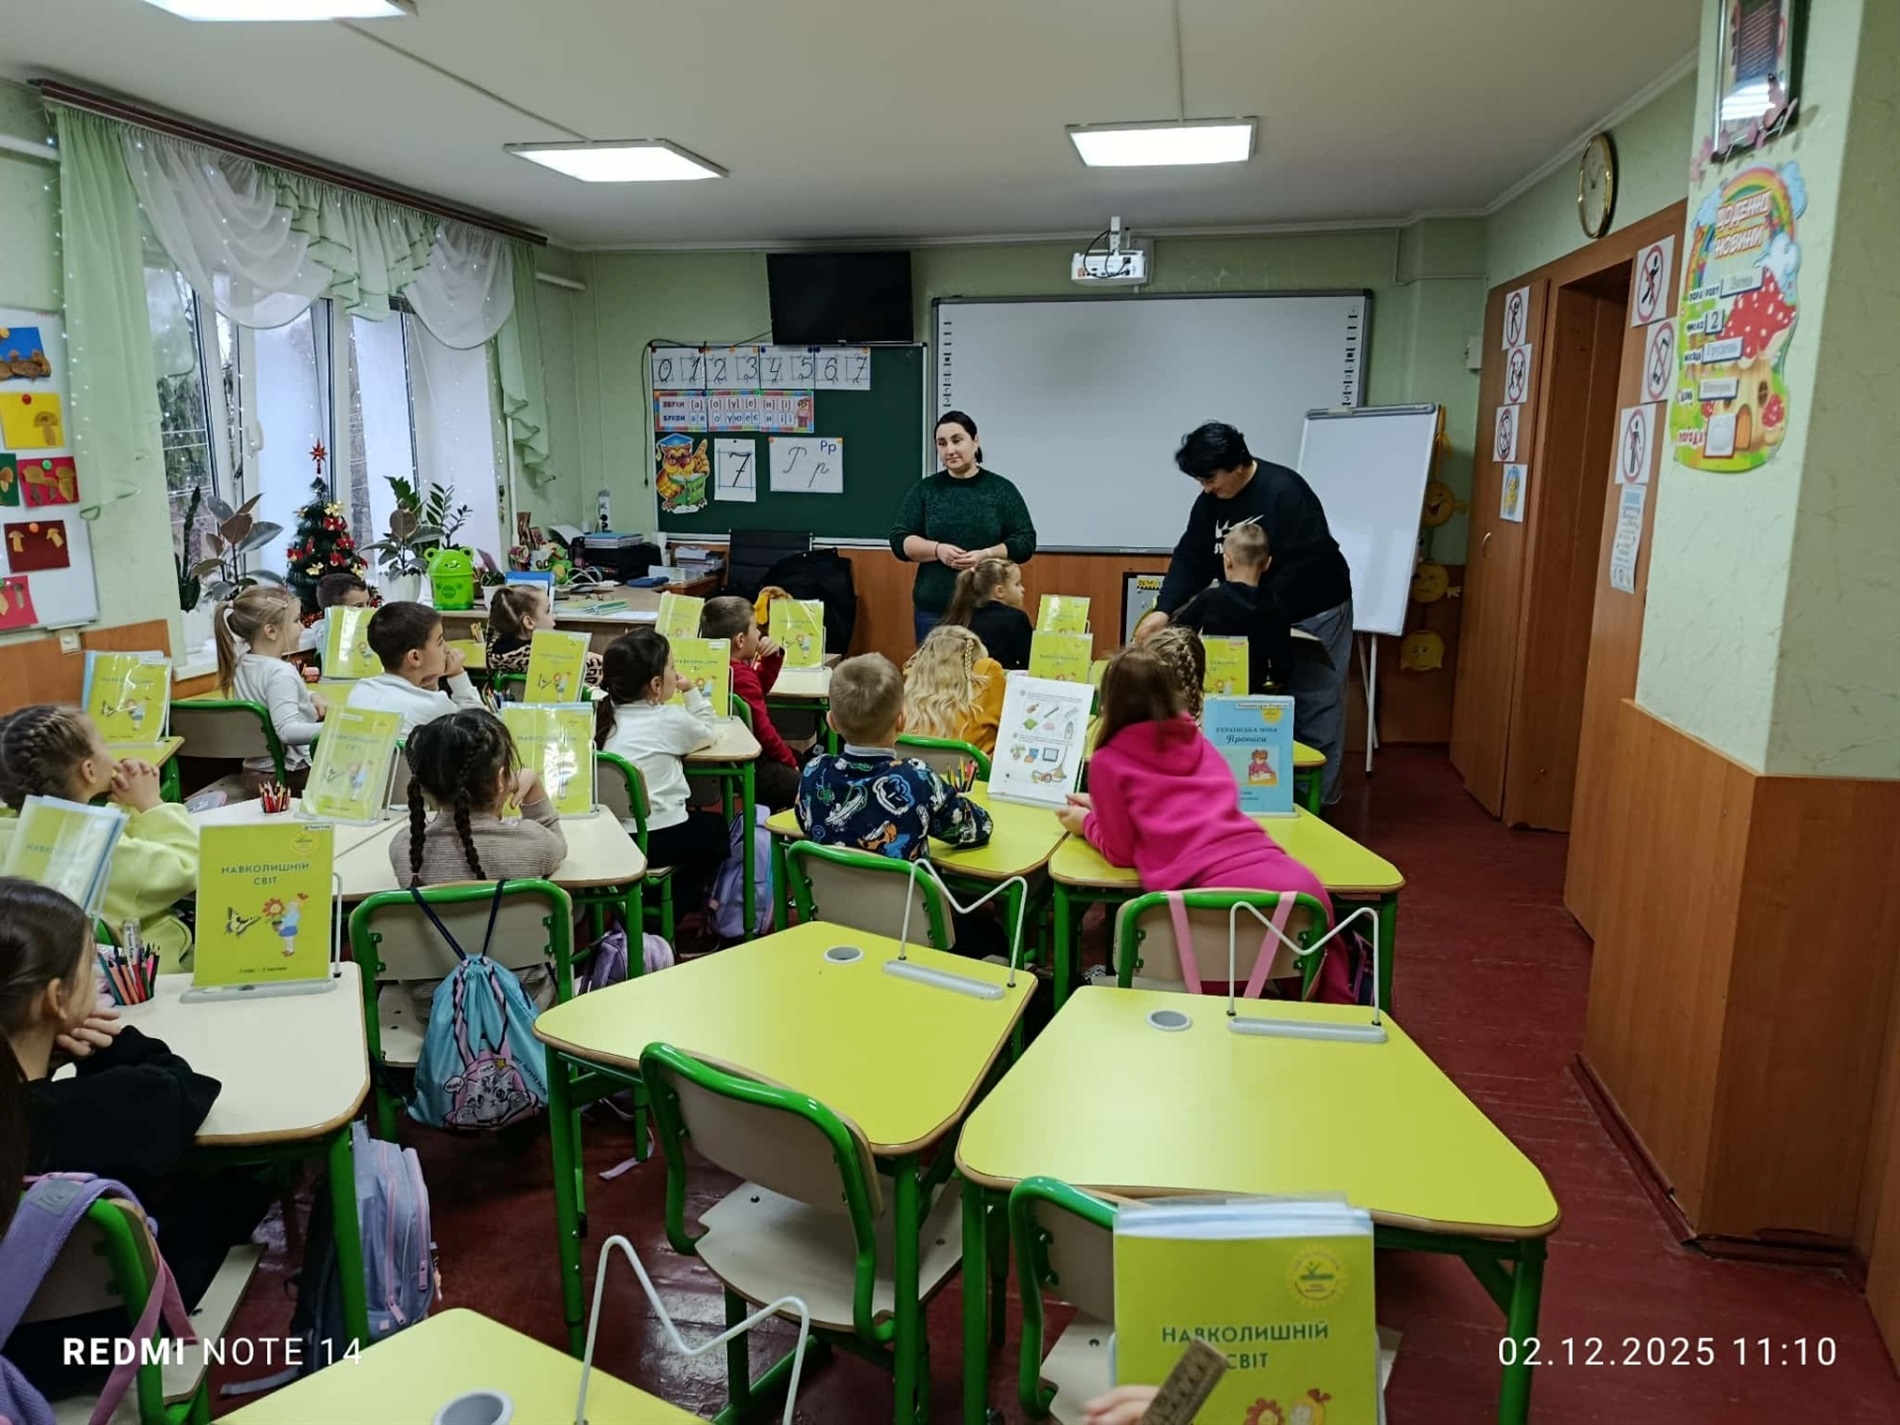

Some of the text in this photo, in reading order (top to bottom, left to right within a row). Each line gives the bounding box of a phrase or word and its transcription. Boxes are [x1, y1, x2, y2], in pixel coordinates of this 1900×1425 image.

[1711, 312, 1719, 329] 2
[658, 356, 868, 382] 0 1 2 3 4 5 6 7
[729, 452, 752, 488] 7
[1226, 734, 1267, 744] Прописи
[221, 862, 310, 875] НАВКОЛИШНІЙ
[253, 877, 278, 886] СВІТ
[1162, 1321, 1329, 1343] НАВКОЛИШНІЙ
[1226, 1353, 1269, 1370] СВІТ
